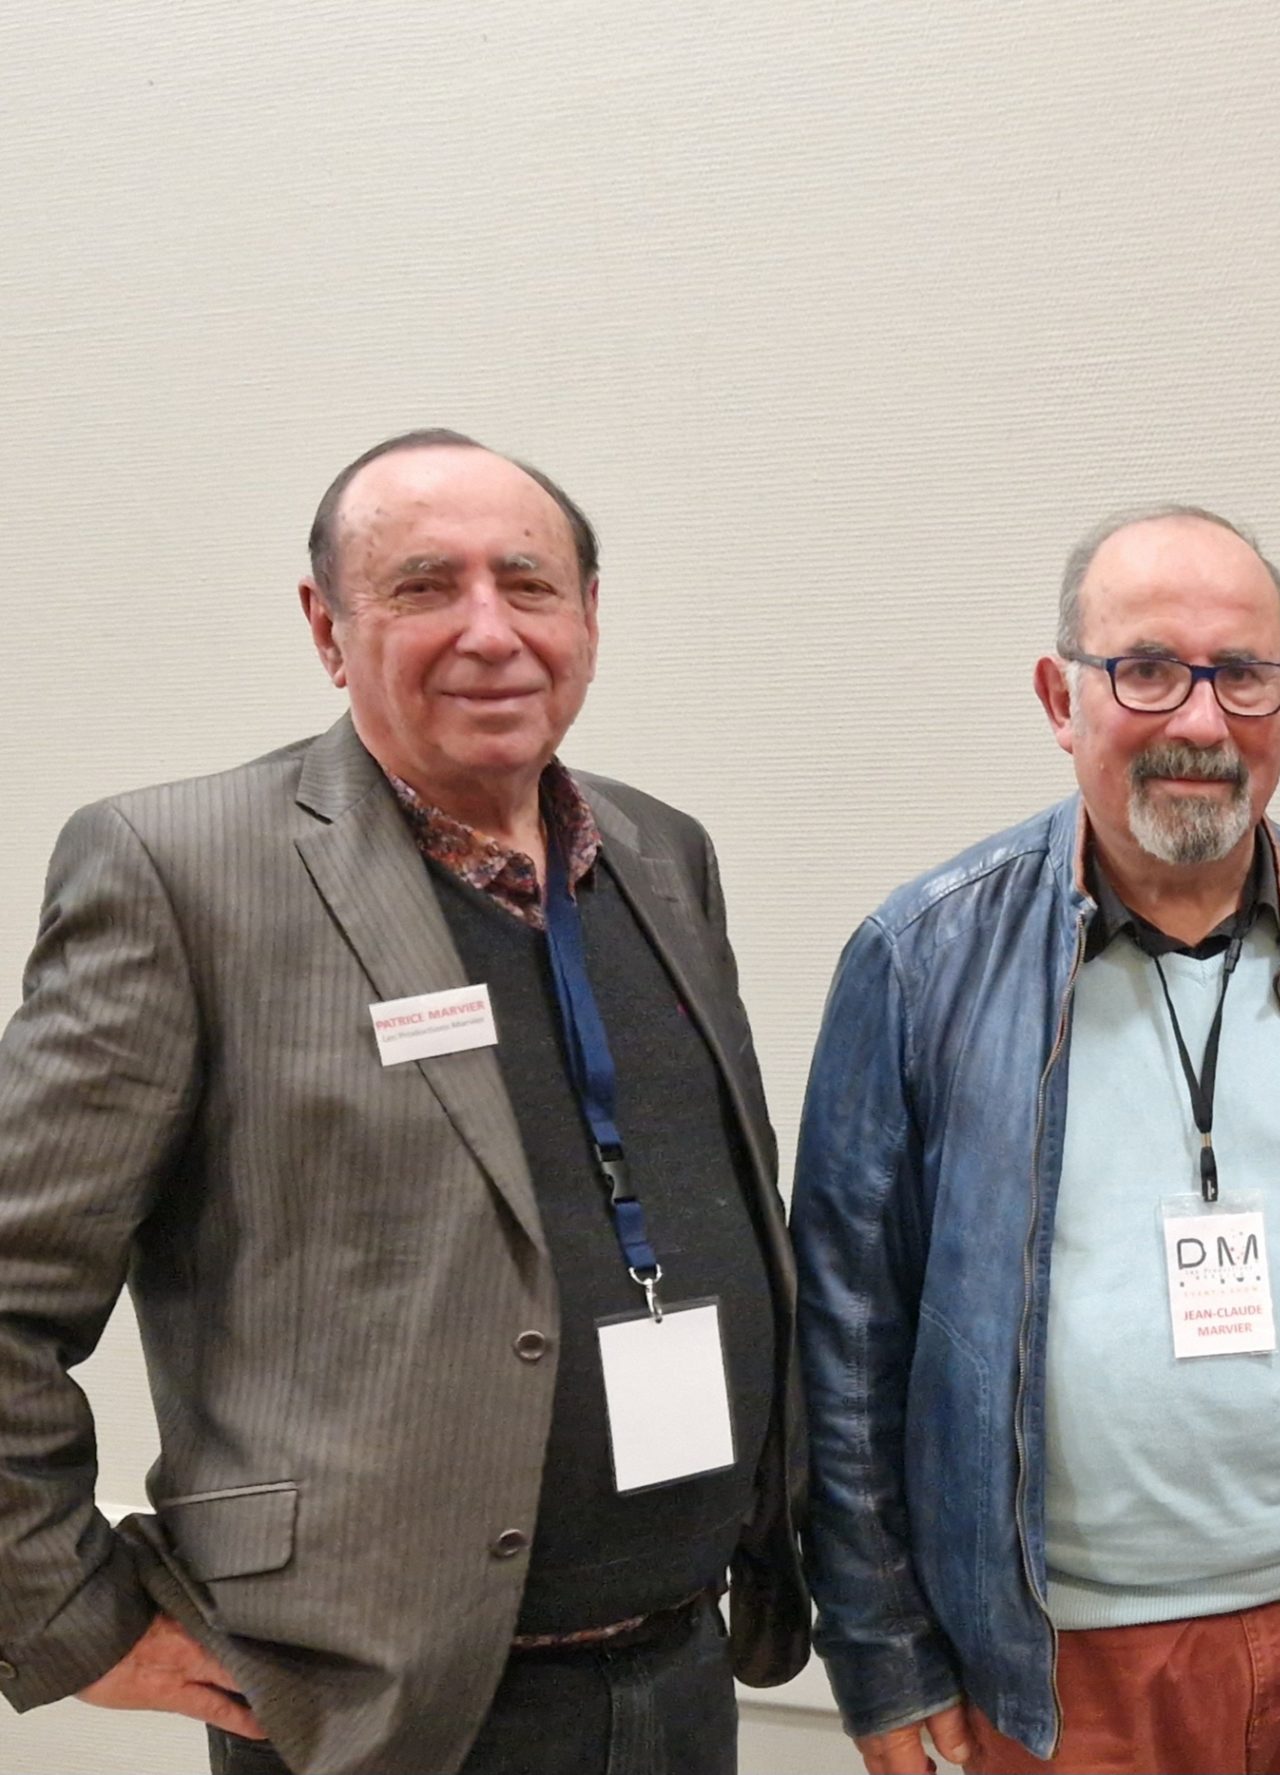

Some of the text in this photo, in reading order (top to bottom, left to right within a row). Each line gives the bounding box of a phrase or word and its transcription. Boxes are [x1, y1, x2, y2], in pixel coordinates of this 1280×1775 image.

[375, 1000, 485, 1030] PATRICE MARVIER
[1183, 1304, 1263, 1321] JEAN-CLAUDE
[1197, 1322, 1253, 1337] MARVIER
